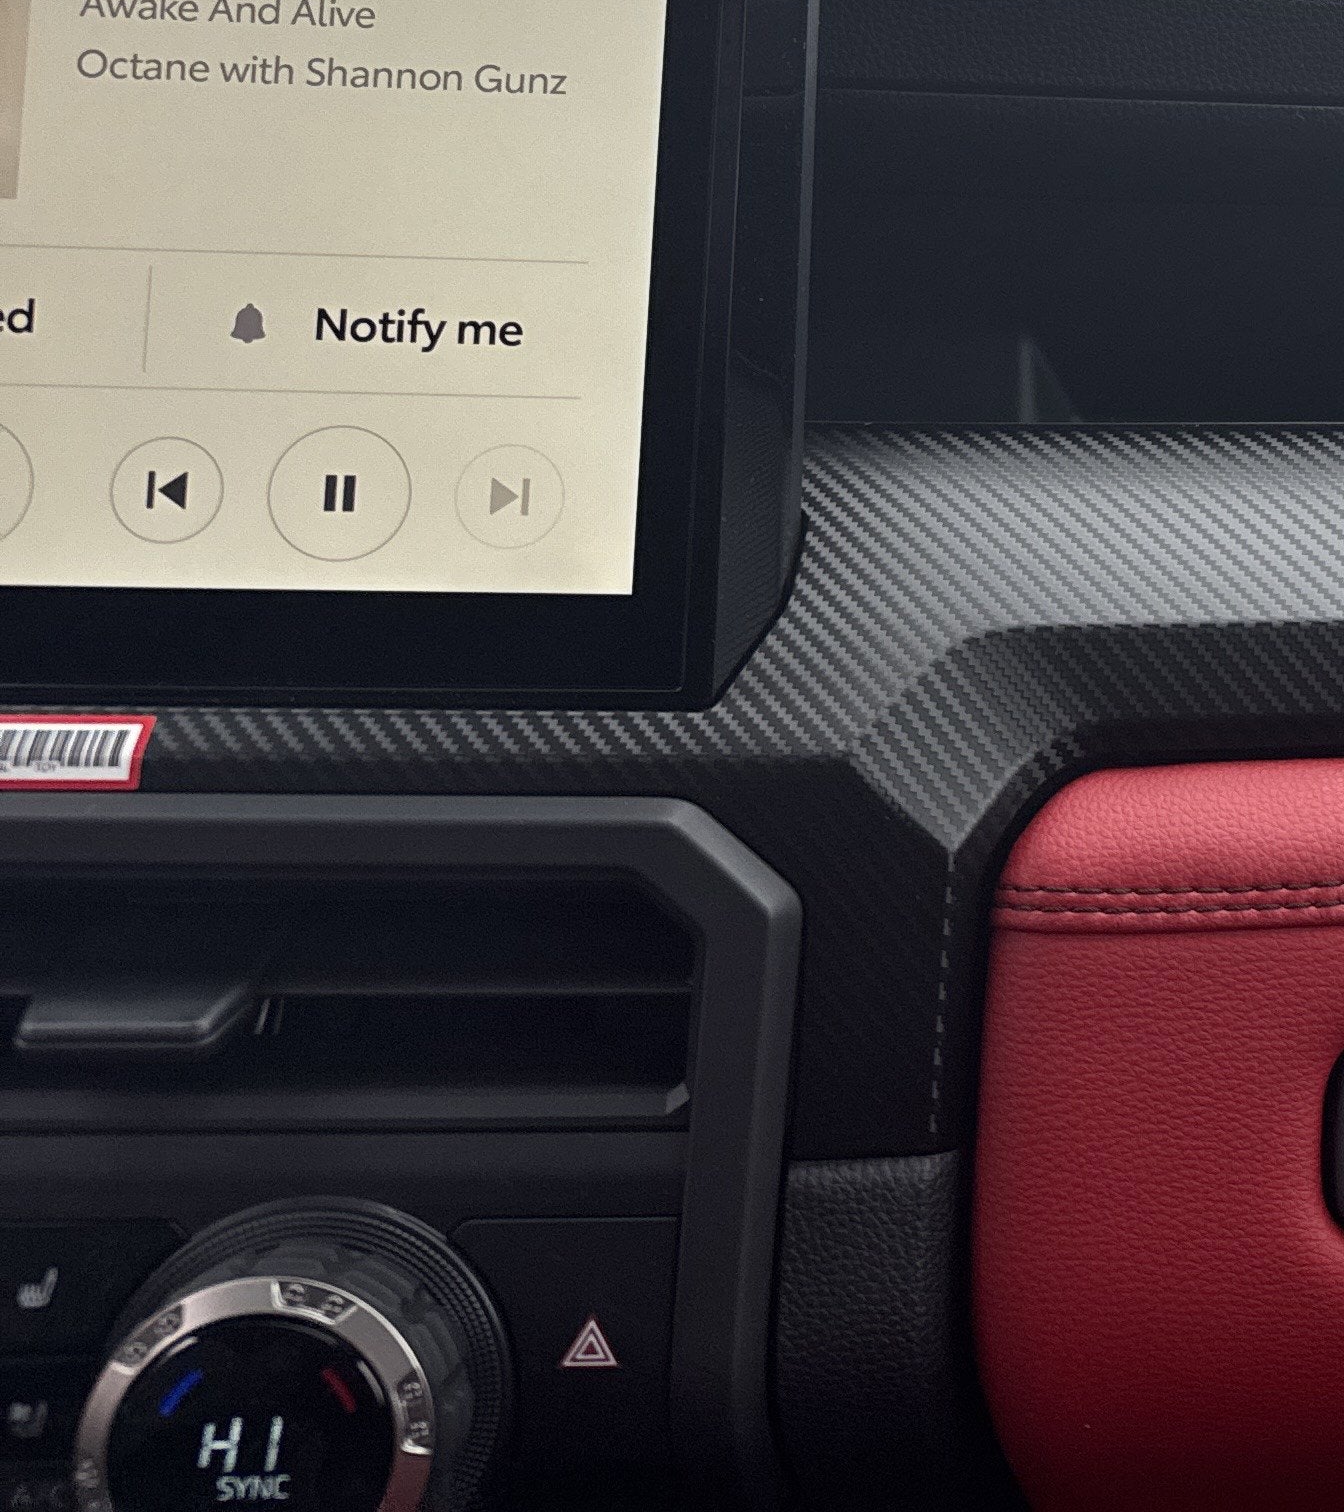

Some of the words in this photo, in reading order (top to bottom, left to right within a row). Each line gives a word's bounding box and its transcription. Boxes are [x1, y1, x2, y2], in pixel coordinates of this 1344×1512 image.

[77, 49, 210, 82] Octane
[220, 54, 295, 85] with
[306, 57, 463, 91] Shannon
[475, 64, 568, 95] Gunz
[315, 307, 447, 353] Notify
[457, 316, 524, 347] me
[197, 1415, 284, 1473] HI
[216, 1474, 291, 1502] SYNC
